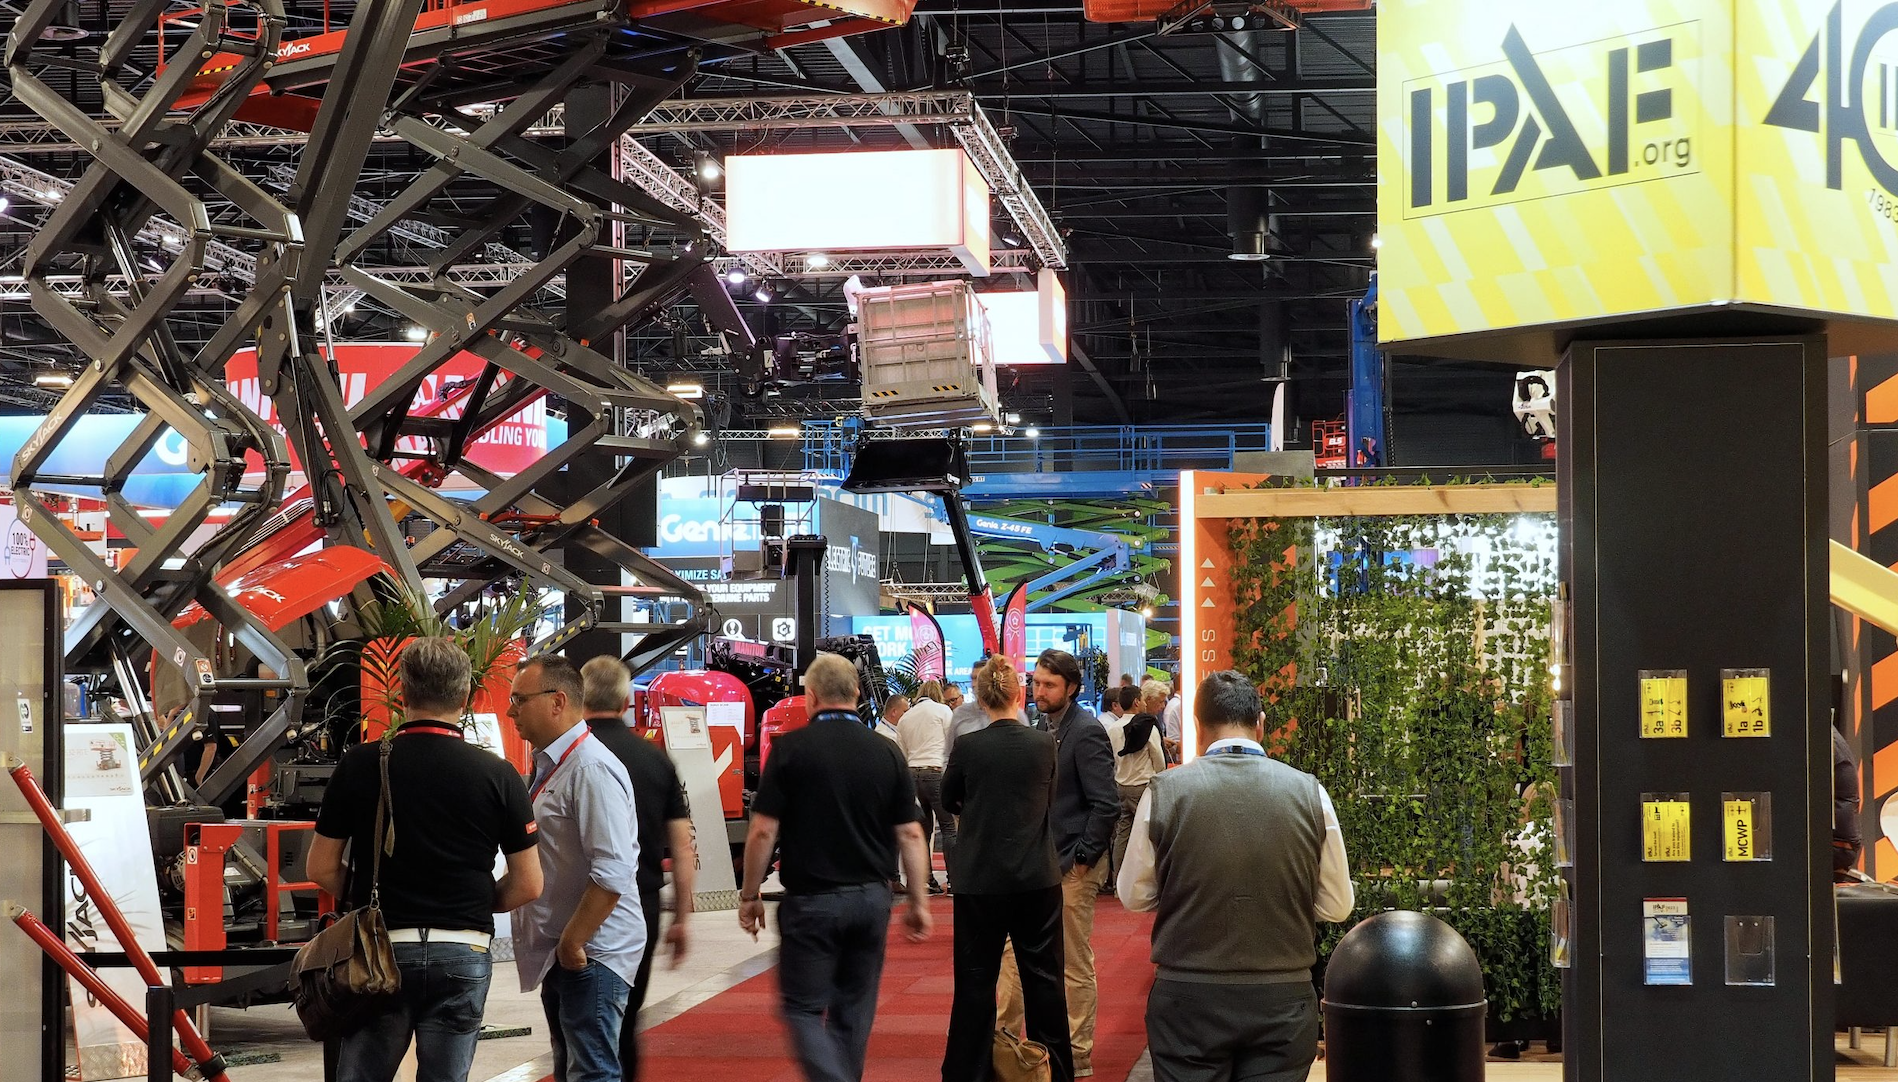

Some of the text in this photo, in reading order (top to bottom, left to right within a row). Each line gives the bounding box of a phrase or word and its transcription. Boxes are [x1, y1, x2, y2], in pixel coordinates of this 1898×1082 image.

[1411, 22, 1672, 208] IPAF
[1634, 137, 1691, 168] .org
[21, 411, 63, 462] SKYJACK
[976, 519, 1033, 535] Genie Z-45 FE
[12, 532, 29, 546] 100%
[490, 533, 525, 559] SKYJACK
[672, 569, 709, 580] XIMIZE
[705, 583, 729, 593] YOUR
[730, 583, 776, 593] EQUIPMENT
[743, 593, 770, 602] PARTS
[1653, 720, 1664, 734] 3a
[1671, 719, 1682, 734] 3b
[1737, 721, 1748, 733] 1a
[1752, 720, 1763, 733] 1b
[1736, 819, 1749, 857] MCWP
